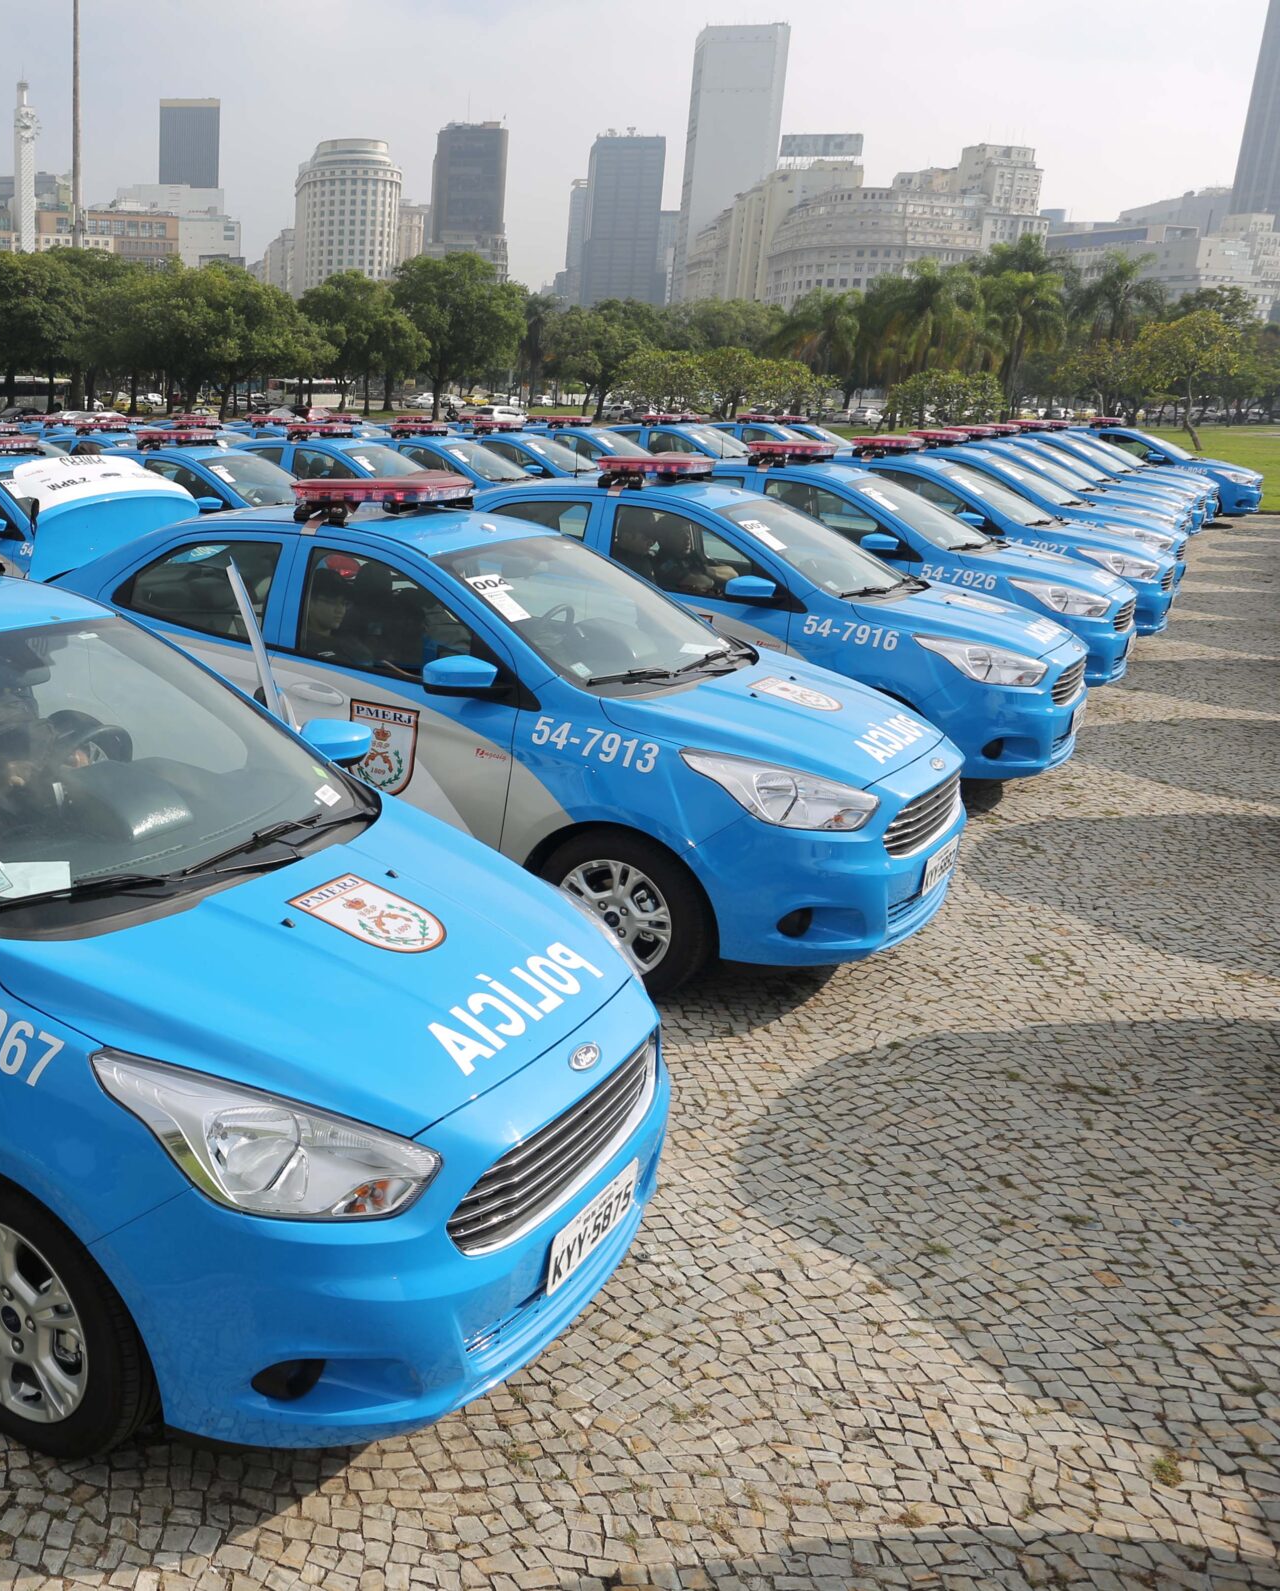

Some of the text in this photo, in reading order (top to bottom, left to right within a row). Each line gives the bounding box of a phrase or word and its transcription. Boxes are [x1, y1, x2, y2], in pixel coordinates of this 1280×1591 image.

[920, 563, 998, 591] 54-7926
[803, 615, 900, 651] 54-7916
[356, 705, 413, 725] PMERJ
[531, 716, 660, 773] 54-7913
[298, 877, 360, 909] PMERJ
